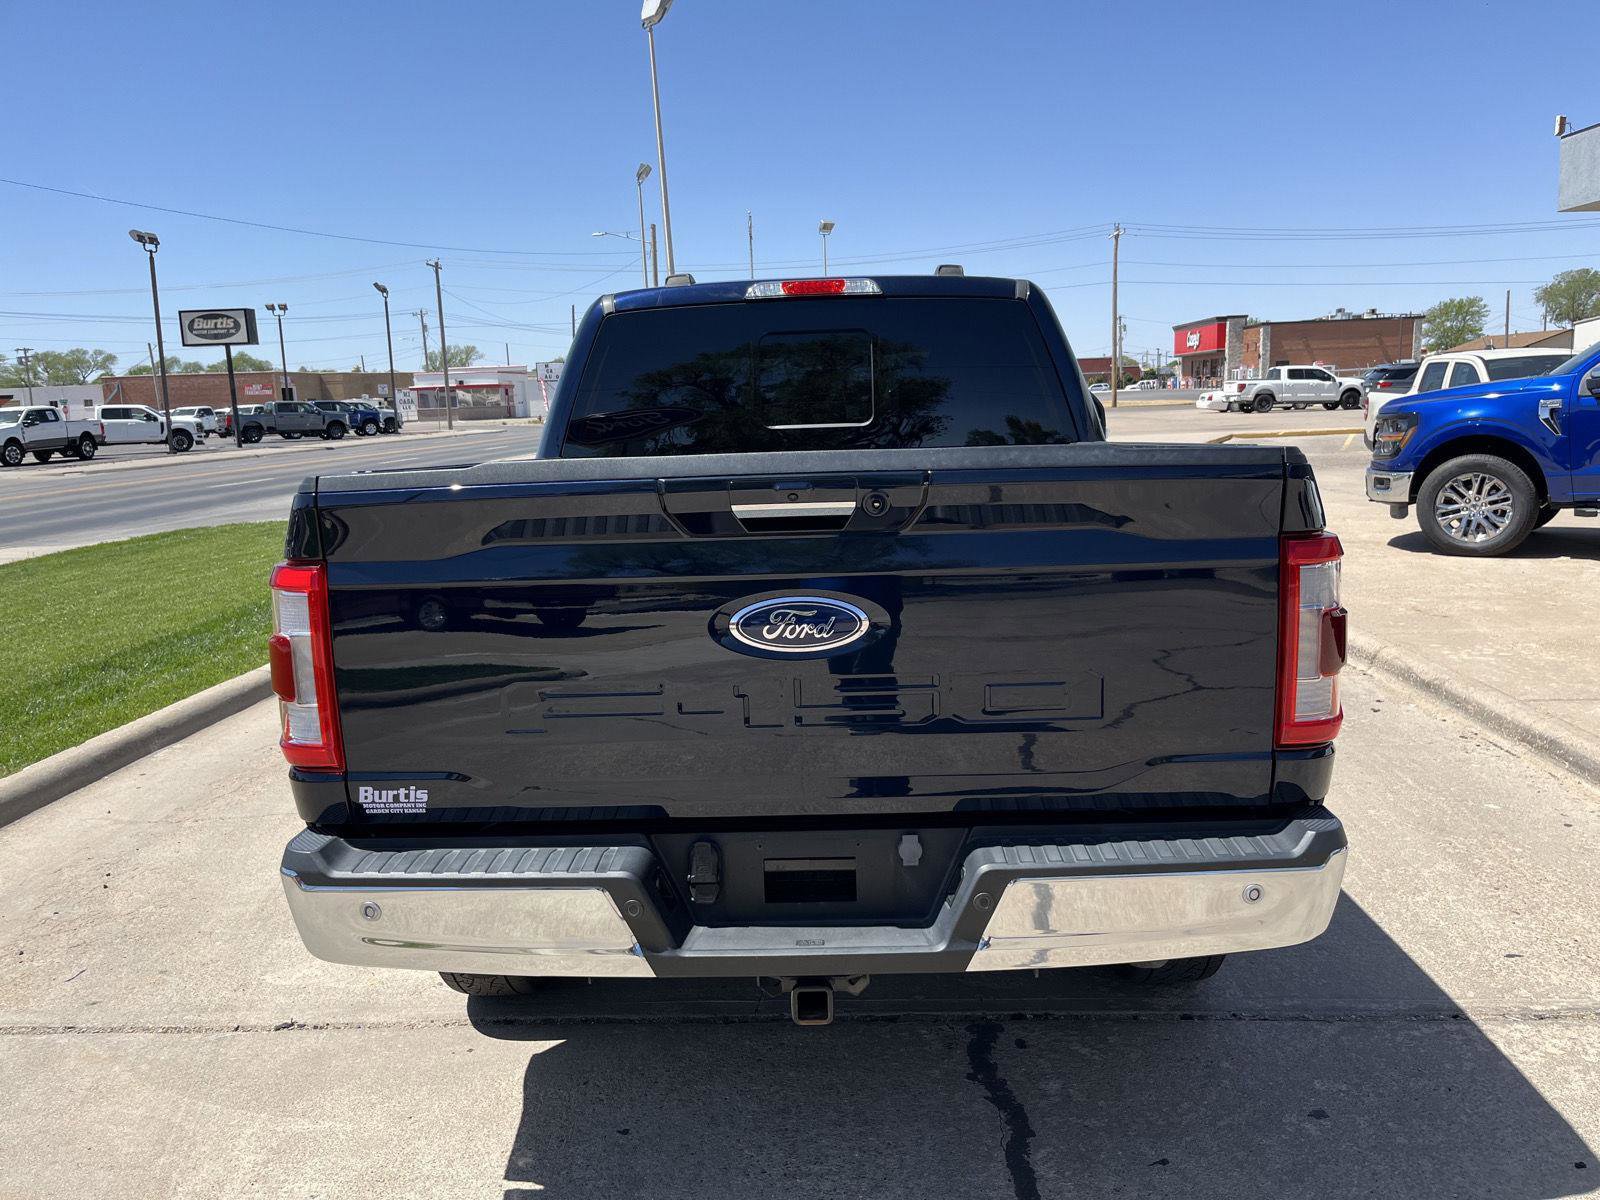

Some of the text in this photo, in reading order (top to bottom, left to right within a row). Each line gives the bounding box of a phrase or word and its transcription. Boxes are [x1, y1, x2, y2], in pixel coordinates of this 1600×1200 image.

[193, 317, 234, 329] Burtis
[762, 609, 836, 640] Ford
[358, 785, 428, 803] Burtis
